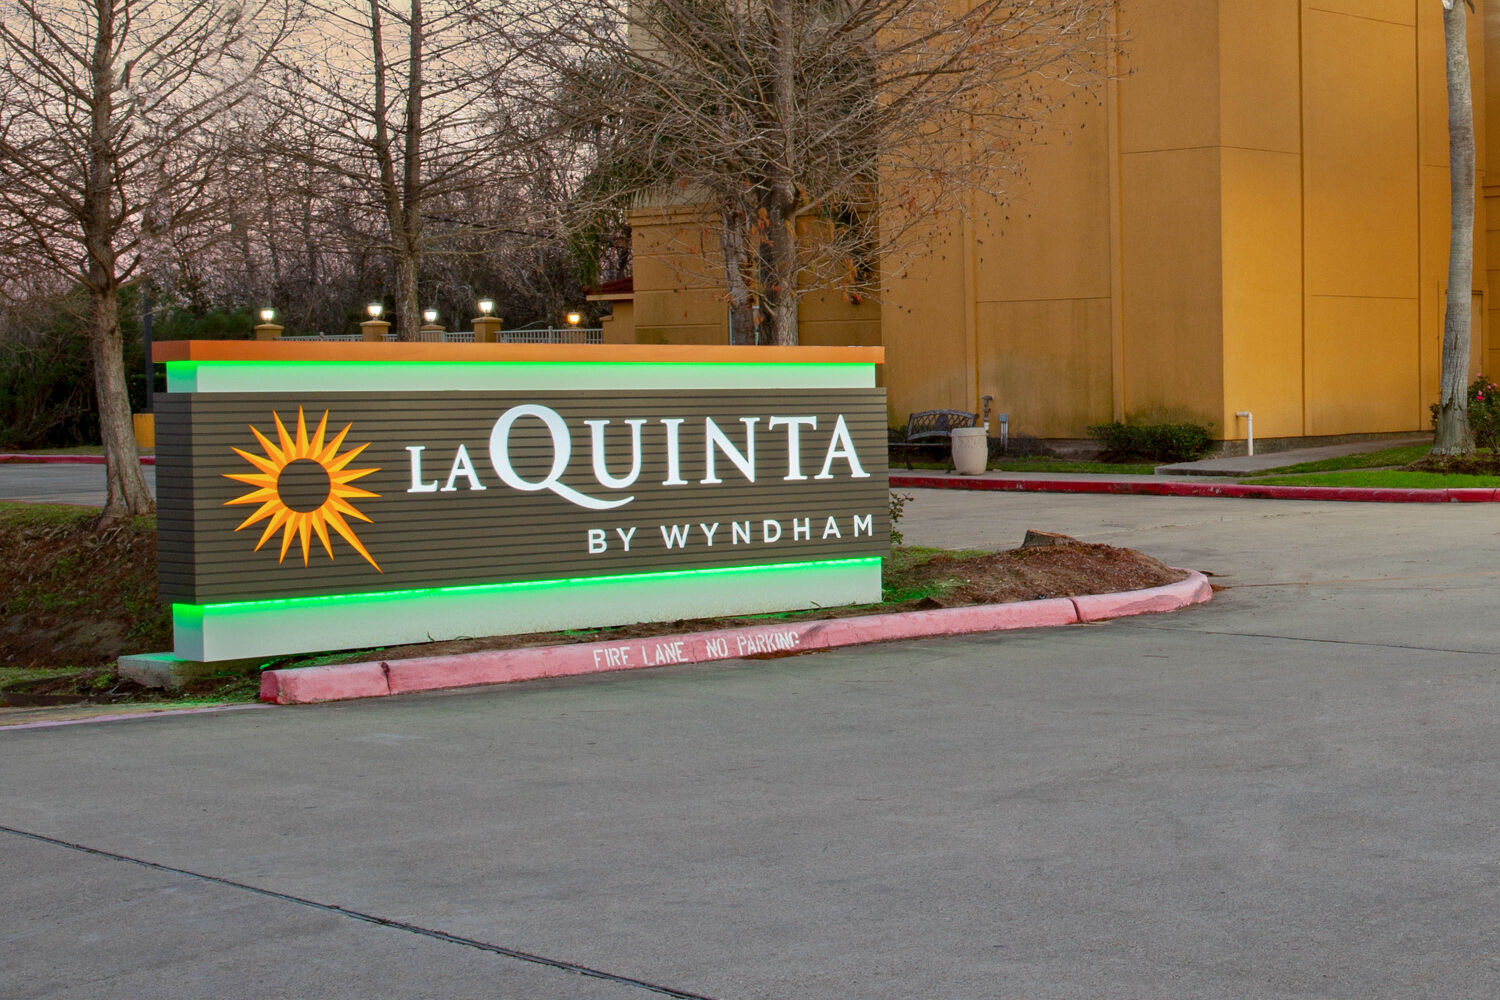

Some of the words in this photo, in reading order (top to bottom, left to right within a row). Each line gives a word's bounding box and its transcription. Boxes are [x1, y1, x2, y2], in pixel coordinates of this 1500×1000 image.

[406, 445, 487, 494] LA
[489, 403, 871, 510] QUINTA
[588, 527, 637, 555] BY
[661, 513, 874, 549] WYNDHAM
[593, 646, 632, 669] FIRE
[643, 641, 688, 667] LANE
[705, 637, 729, 659] NO
[736, 630, 800, 656] PARKING
